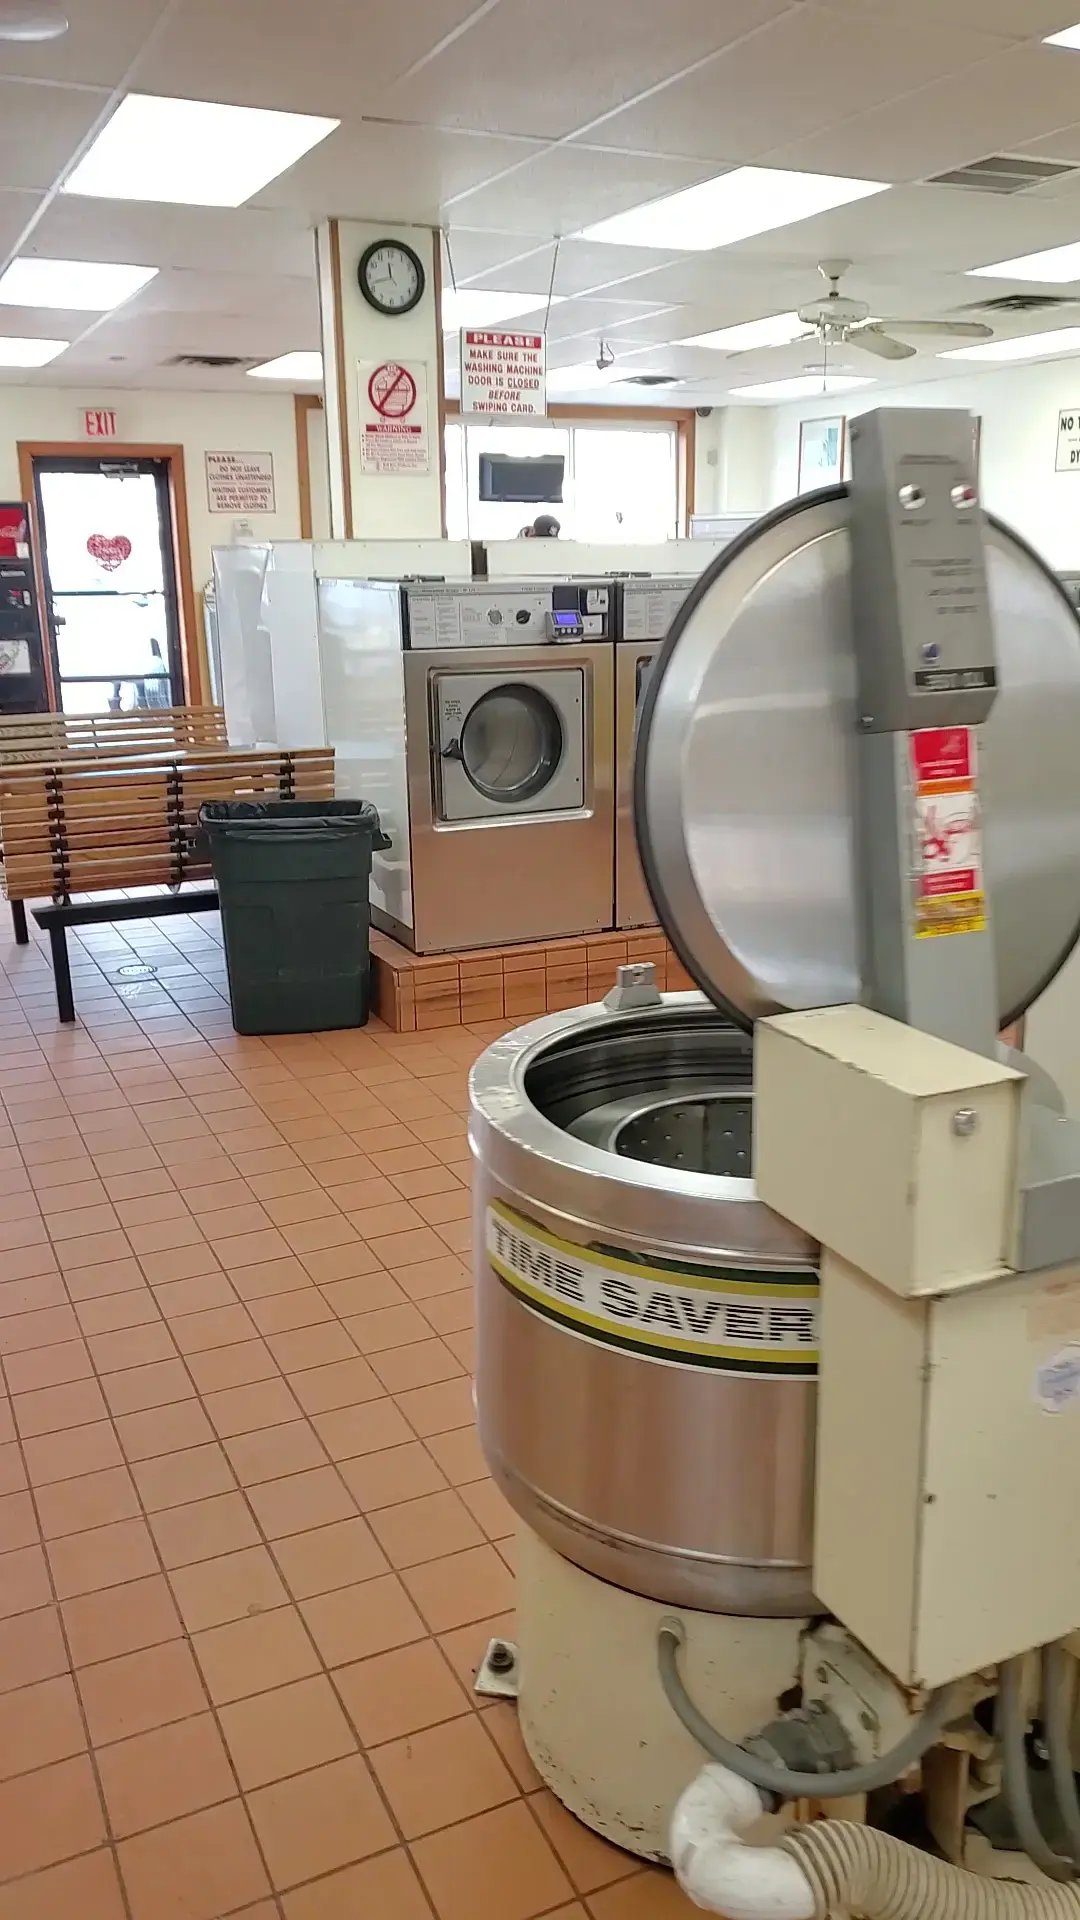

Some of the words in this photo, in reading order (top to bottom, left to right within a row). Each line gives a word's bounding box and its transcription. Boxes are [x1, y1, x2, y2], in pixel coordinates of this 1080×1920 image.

[473, 332, 535, 347] PLEASE
[469, 349, 494, 360] MAKE
[497, 351, 519, 361] SURE
[523, 352, 538, 362] THE
[464, 362, 503, 373] WASHING
[506, 364, 543, 376] MACHINE
[468, 375, 492, 386] DOOR
[496, 377, 504, 386] IS
[507, 378, 540, 389] CLOSED
[488, 391, 522, 401] BEFORE
[473, 400, 508, 411] SWIPING
[511, 403, 536, 413] CARD.
[85, 411, 117, 436] EXIT
[376, 425, 412, 433] WARNING
[1060, 416, 1074, 431] NO
[491, 1219, 585, 1303] TIME
[600, 1279, 818, 1343] SAVER
